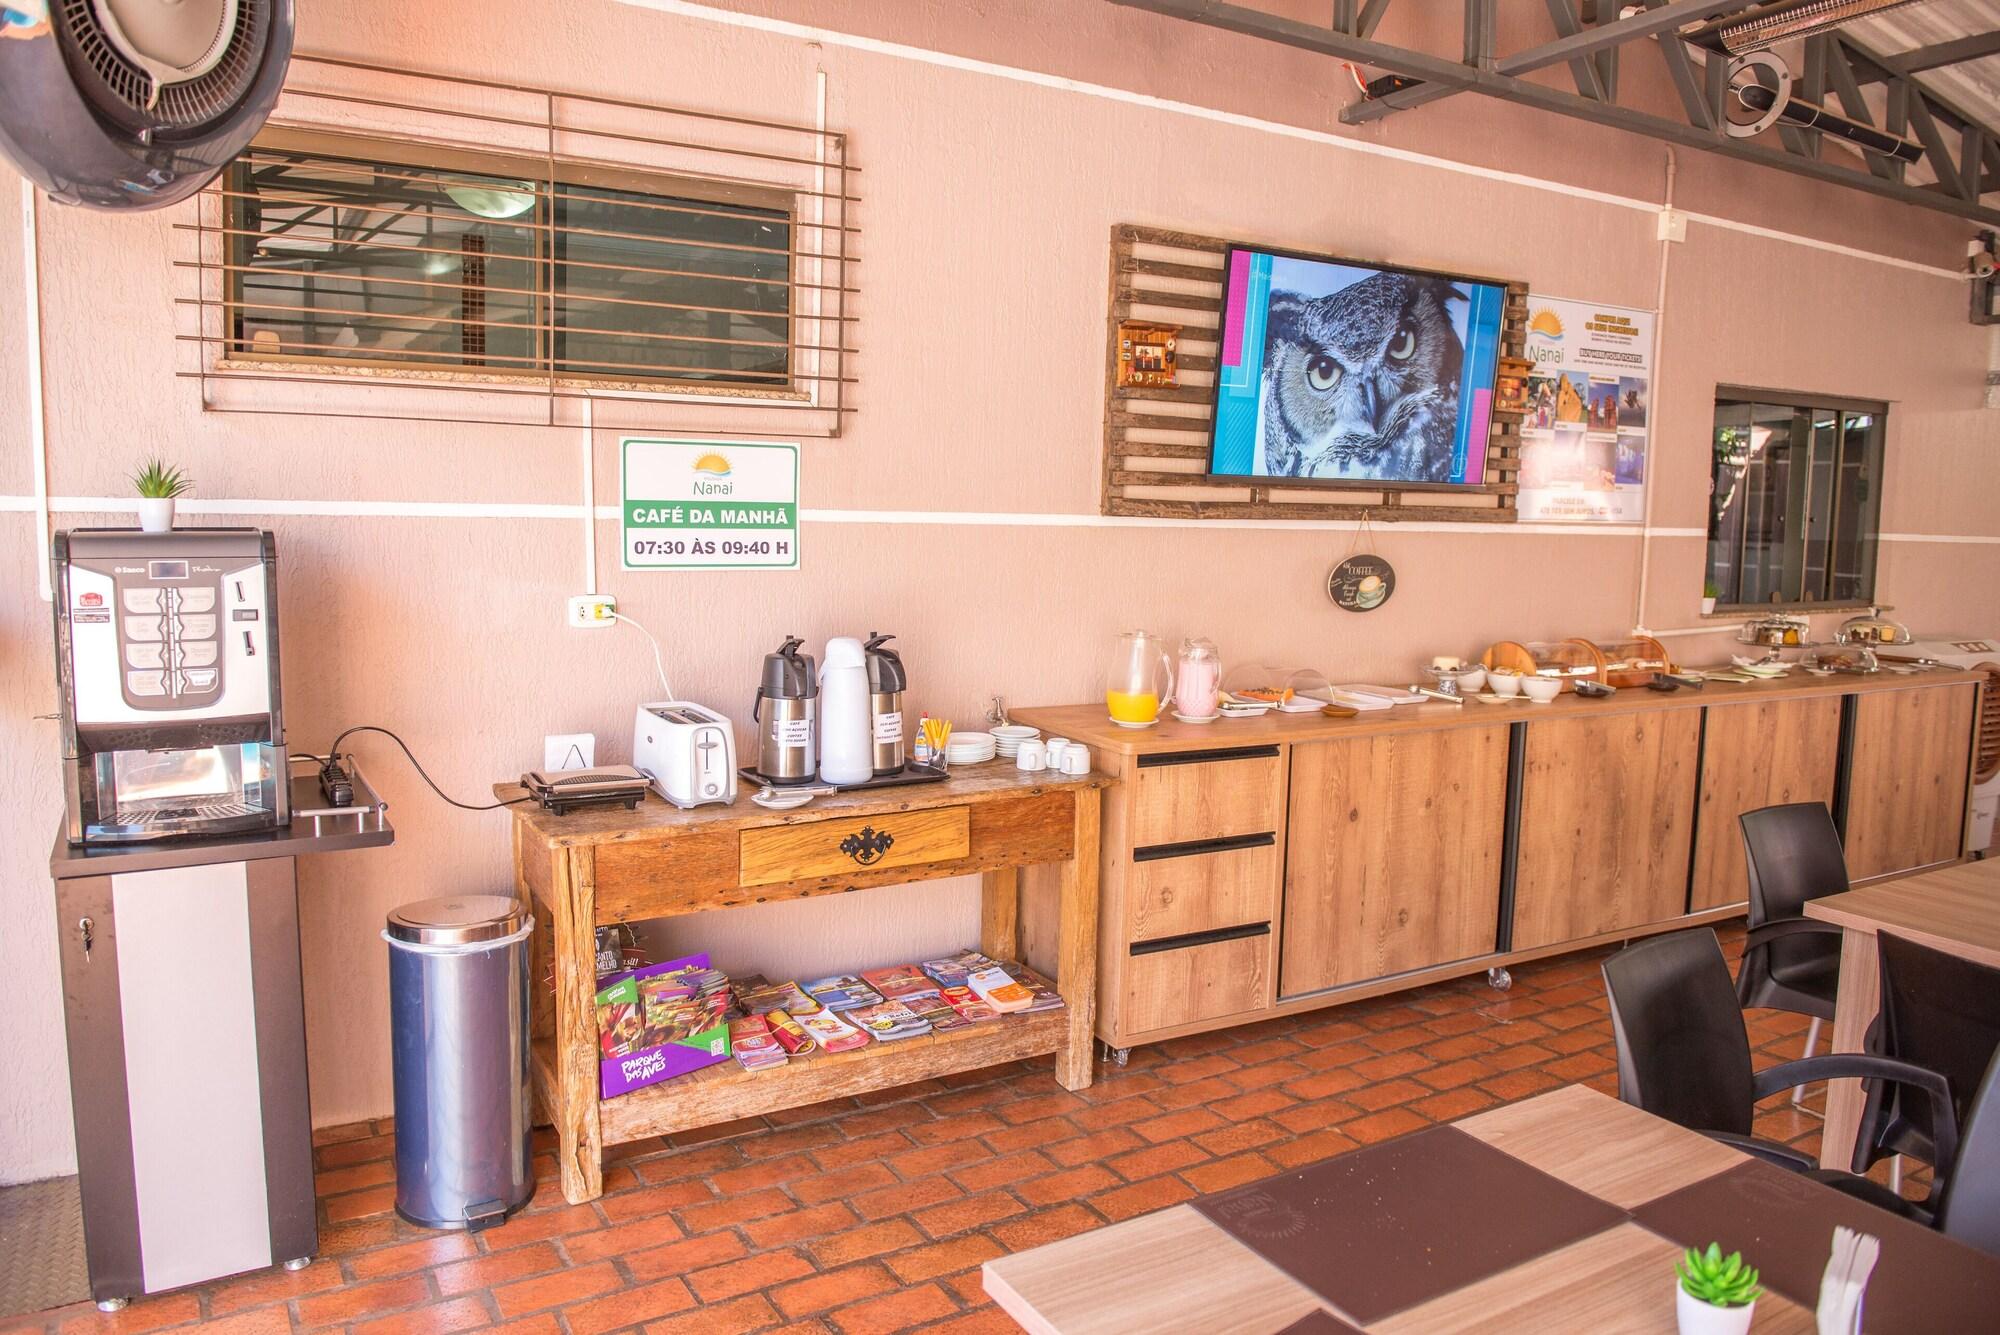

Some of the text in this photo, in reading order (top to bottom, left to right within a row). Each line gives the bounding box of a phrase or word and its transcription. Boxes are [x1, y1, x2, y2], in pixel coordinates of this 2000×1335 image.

[1529, 345, 1564, 364] Nanai
[693, 481, 733, 495] Nanai
[632, 506, 788, 524] CAFÉ DA MANHÃ
[634, 537, 789, 555] 07:30 ÀS 09:40 H
[1348, 567, 1373, 575] COFFEE
[621, 1049, 663, 1074] PARQUE
[625, 1057, 666, 1083] DAS AVES
